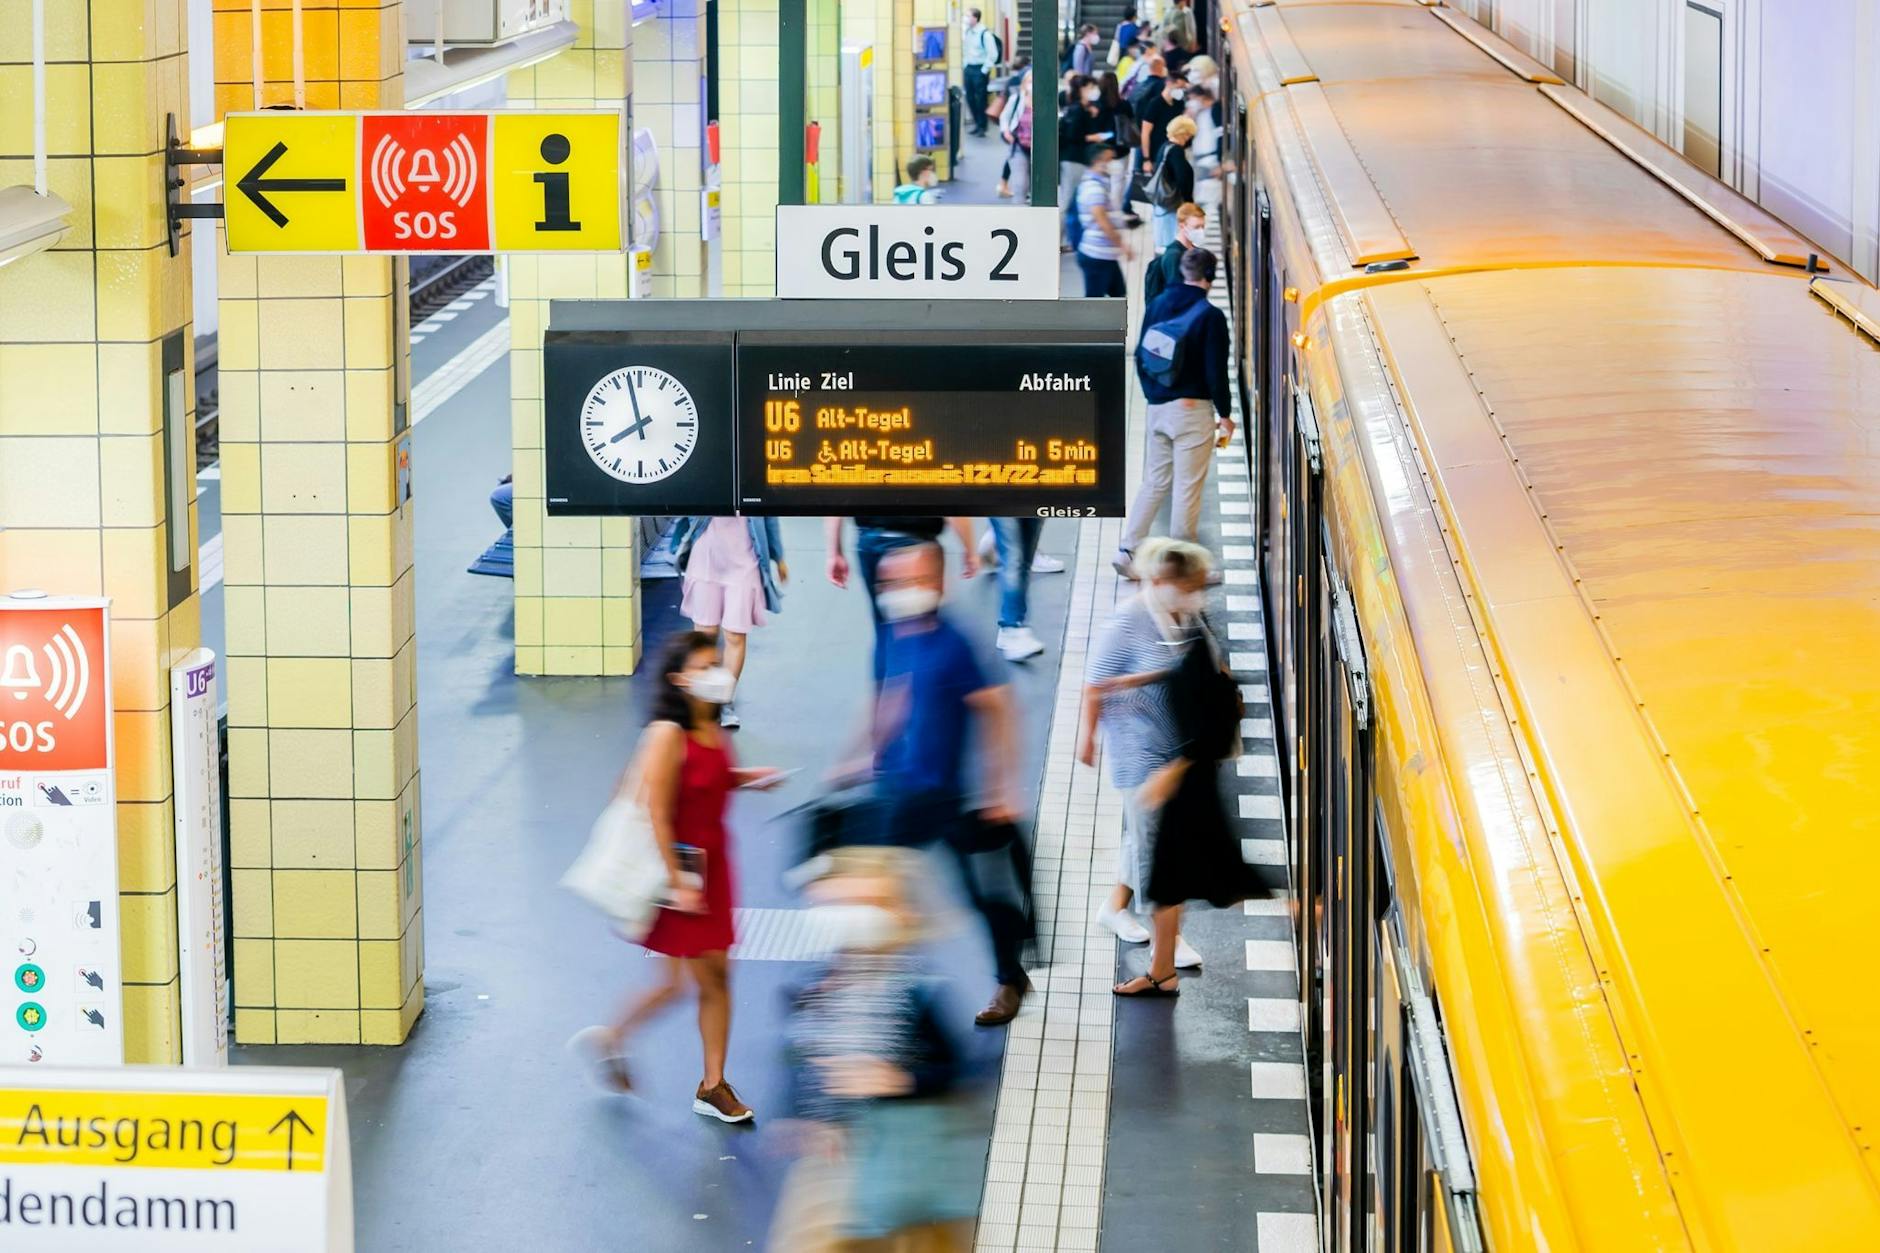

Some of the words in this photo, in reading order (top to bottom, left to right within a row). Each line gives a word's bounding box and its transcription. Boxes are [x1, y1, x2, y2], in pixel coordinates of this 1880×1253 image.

[393, 211, 457, 239] SOS
[821, 224, 966, 281] Gleis
[989, 228, 1019, 281] 2
[820, 373, 854, 390] Ziel
[1019, 373, 1091, 391] Abfahrt
[765, 401, 800, 431] U6
[817, 408, 910, 430] Alt-Tegel
[766, 440, 792, 460] U6
[840, 440, 933, 462] Alt-Tegel
[1017, 440, 1037, 460] in
[1049, 440, 1063, 460] 5
[1065, 440, 1096, 460] min
[1037, 506, 1080, 517] Gleis
[1087, 506, 1096, 517] 2
[188, 669, 206, 696] U6
[17, 1103, 238, 1166] Ausgang
